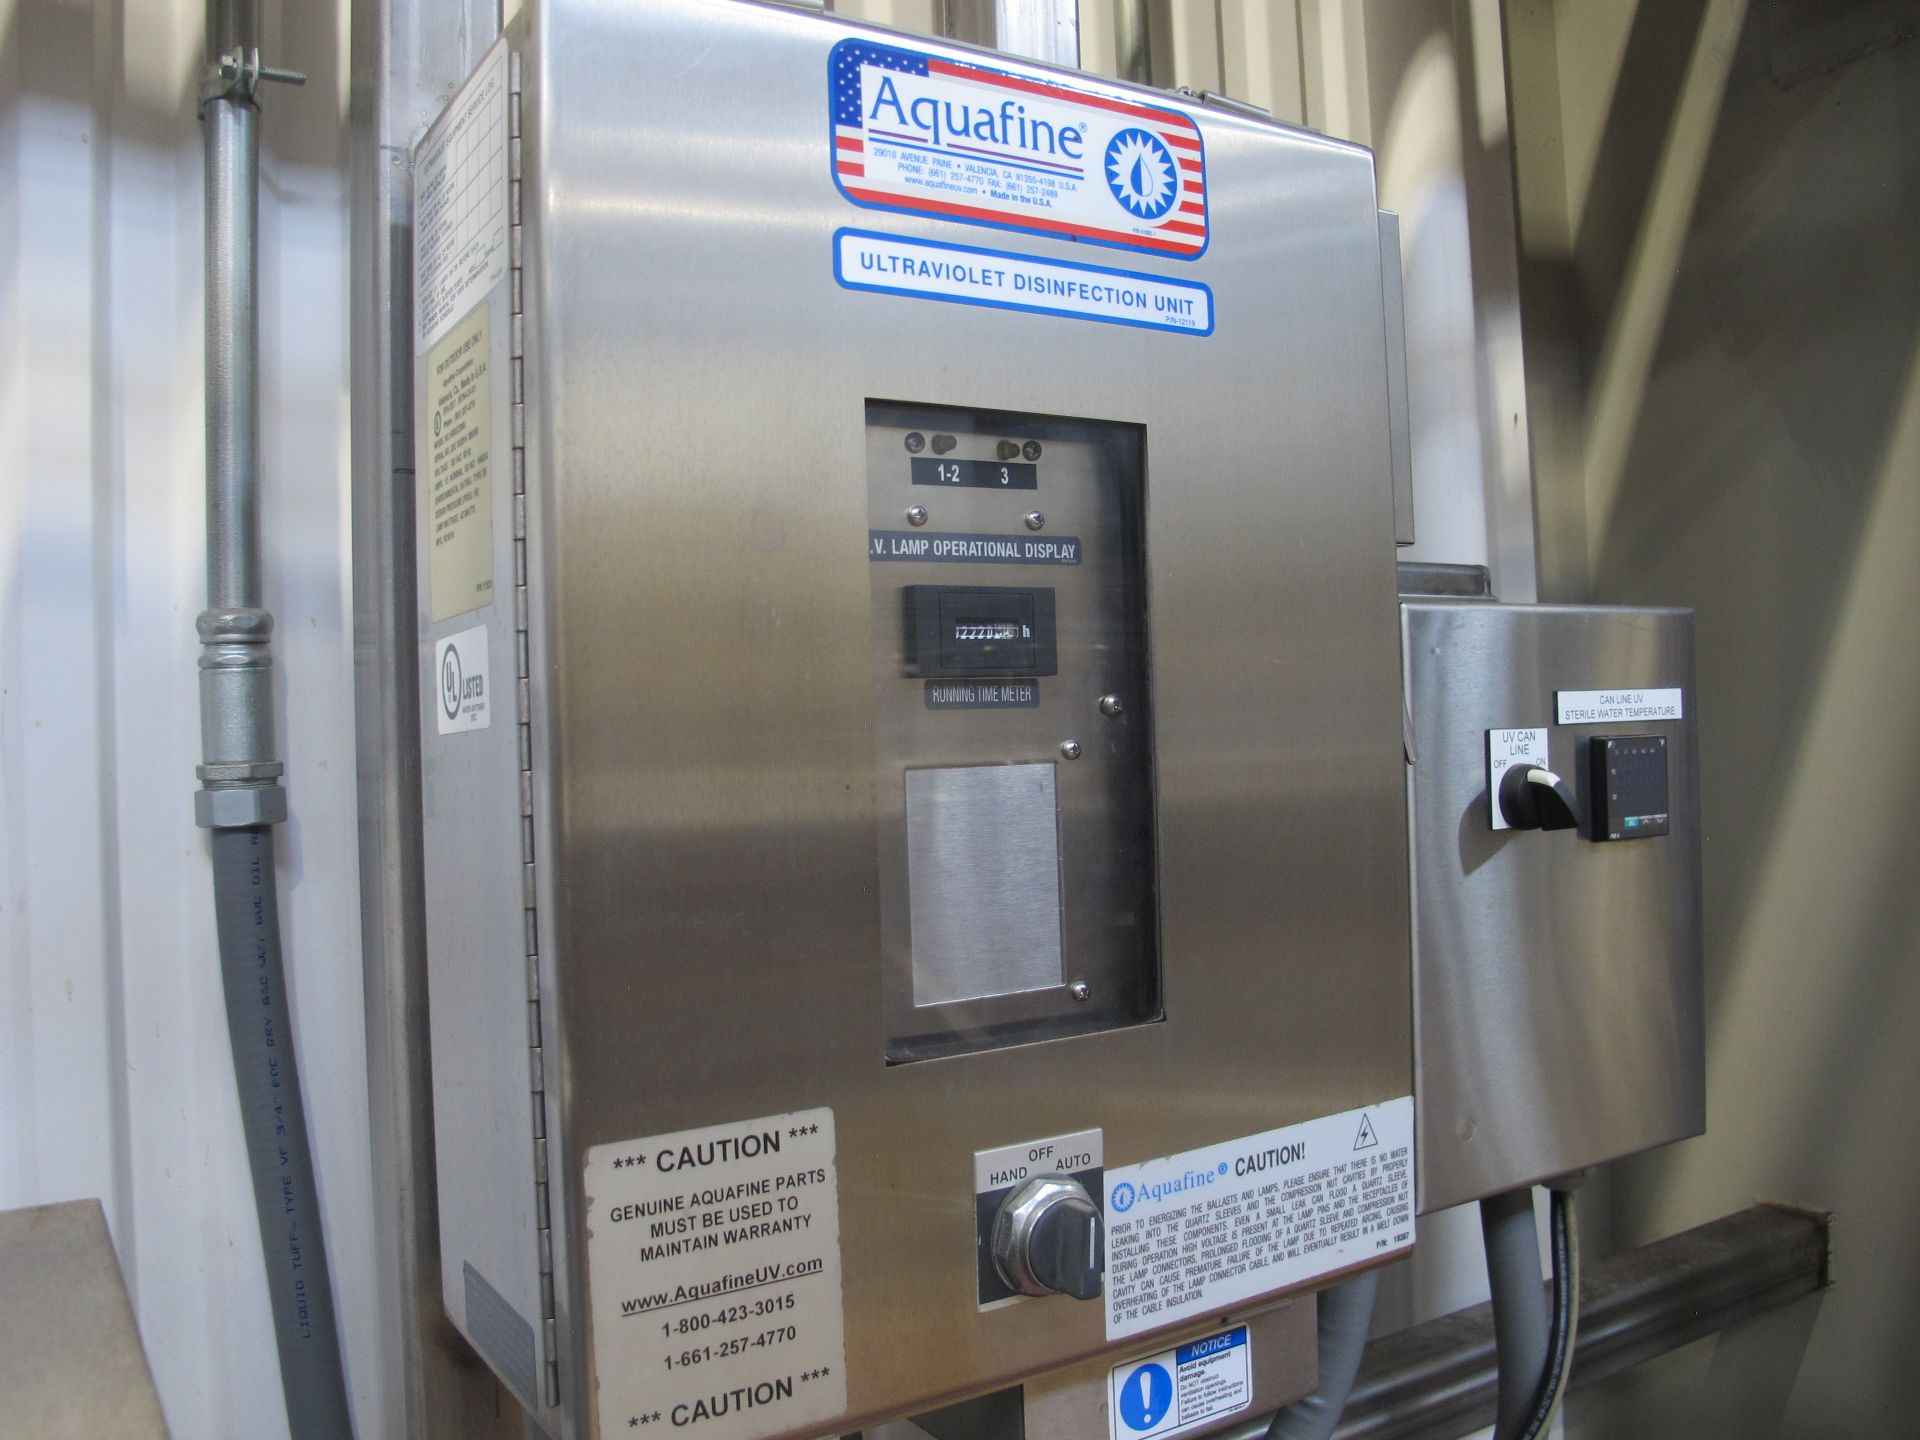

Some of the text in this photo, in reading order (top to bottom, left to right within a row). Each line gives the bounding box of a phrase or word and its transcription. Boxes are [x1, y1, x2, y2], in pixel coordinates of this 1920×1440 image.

[874, 147, 897, 160] 29010
[900, 152, 929, 165] AVENUE
[932, 157, 952, 170] PAINE
[1002, 171, 1012, 180] CA
[1015, 173, 1056, 188] 91355-4198
[1059, 181, 1078, 192] U.S.A.
[897, 163, 924, 176] PHONE:
[928, 169, 947, 180] (661)
[950, 172, 984, 186] 257-4770
[1005, 181, 1023, 193] (661)
[1026, 185, 1058, 198] 257-2489
[904, 175, 1053, 208] www.aquafineuv.com Made in the U.S.A.
[860, 250, 1194, 315] ULTRAVIOLET DISINFECTION UNIT
[937, 464, 1009, 484] 1-2 3
[891, 539, 929, 555] LAMP
[933, 540, 1021, 558] OPERATIONAL
[1025, 543, 1076, 559] DISPLAY
[1022, 624, 1031, 638] h
[462, 674, 484, 700] LISTED
[933, 686, 1032, 702] RUNNING TIME METER
[1599, 694, 1644, 705] CAN LINE UV
[1565, 706, 1675, 720] STERILE WATER TEMPERATURE
[1502, 731, 1536, 743] UV CAN
[1509, 744, 1530, 756] LINE
[1493, 758, 1546, 769] OFF ON
[279, 1147, 289, 1166] VF
[656, 1131, 781, 1172] CAUTION
[990, 1153, 1091, 1186] HAND AUTO
[1028, 1146, 1054, 1162] OFF
[1137, 1141, 1306, 1204] Aquafine CAUTION!
[282, 1176, 294, 1215] TYPE
[610, 1169, 826, 1223] GENUINE AQUAFINE PARTS
[1110, 1222, 1131, 1236] PRIOR
[1135, 1218, 1144, 1230] TO
[1148, 1207, 1186, 1226] ENERGIZING
[1191, 1202, 1202, 1214] THE
[1207, 1193, 1237, 1210] BALLASTS
[1241, 1188, 1254, 1201] AND
[1283, 1175, 1304, 1189] PLEASE
[1308, 1168, 1329, 1182] ENSURE
[1333, 1163, 1347, 1175] THAT
[1350, 1157, 1367, 1170] THERE
[650, 1196, 799, 1239] MUST BE USED TO
[1111, 1242, 1149, 1262] INSTALLING
[1156, 1234, 1176, 1249] THESE
[1234, 1214, 1250, 1227] EVEN
[1265, 1204, 1285, 1218] SMALL
[1291, 1198, 1306, 1210] LEAK
[1311, 1193, 1323, 1204] CAN
[1328, 1186, 1347, 1199] FLOOD
[1361, 1176, 1382, 1190] QUARTZ
[1111, 1195, 1275, 1249] LEAKING INTO THE QUARTZ SLEEVES AND THE
[1112, 1197, 1345, 1274] DURING OPERATION HIGH VOLTAGE IS PRESENT AT THE AND
[640, 1214, 812, 1262] MAINTAIN WARRANTY
[1112, 1274, 1125, 1287] THE
[1129, 1267, 1148, 1281] LAMP
[1200, 1241, 1238, 1261] PROLONGED
[1241, 1231, 1271, 1249] FLOODING
[1275, 1228, 1283, 1239] OF
[1293, 1218, 1316, 1233] QUARTZ
[1319, 1211, 1339, 1225] SLEEVE
[1113, 1226, 1326, 1299] CAVITY CAN CAUSE PREMATURE FAILURE OF THE LAMP TO
[1113, 1234, 1337, 1312] OVERHEATING OF THE LAMP CONNECTOR AND WILL EVENTUALLY
[621, 1256, 823, 1314] www.AquafineUV.com
[295, 1280, 310, 1339] LIQUID
[661, 1294, 796, 1337] 1-800-423-3015
[1113, 1312, 1122, 1324] OF
[1126, 1307, 1138, 1320] THE
[1141, 1300, 1162, 1315] CABLE
[663, 1325, 797, 1370] 1-661-257-4770
[1179, 1351, 1231, 1373] Avoid equipment
[1191, 1334, 1232, 1357] NOTICE
[670, 1376, 793, 1427] CAUTION
